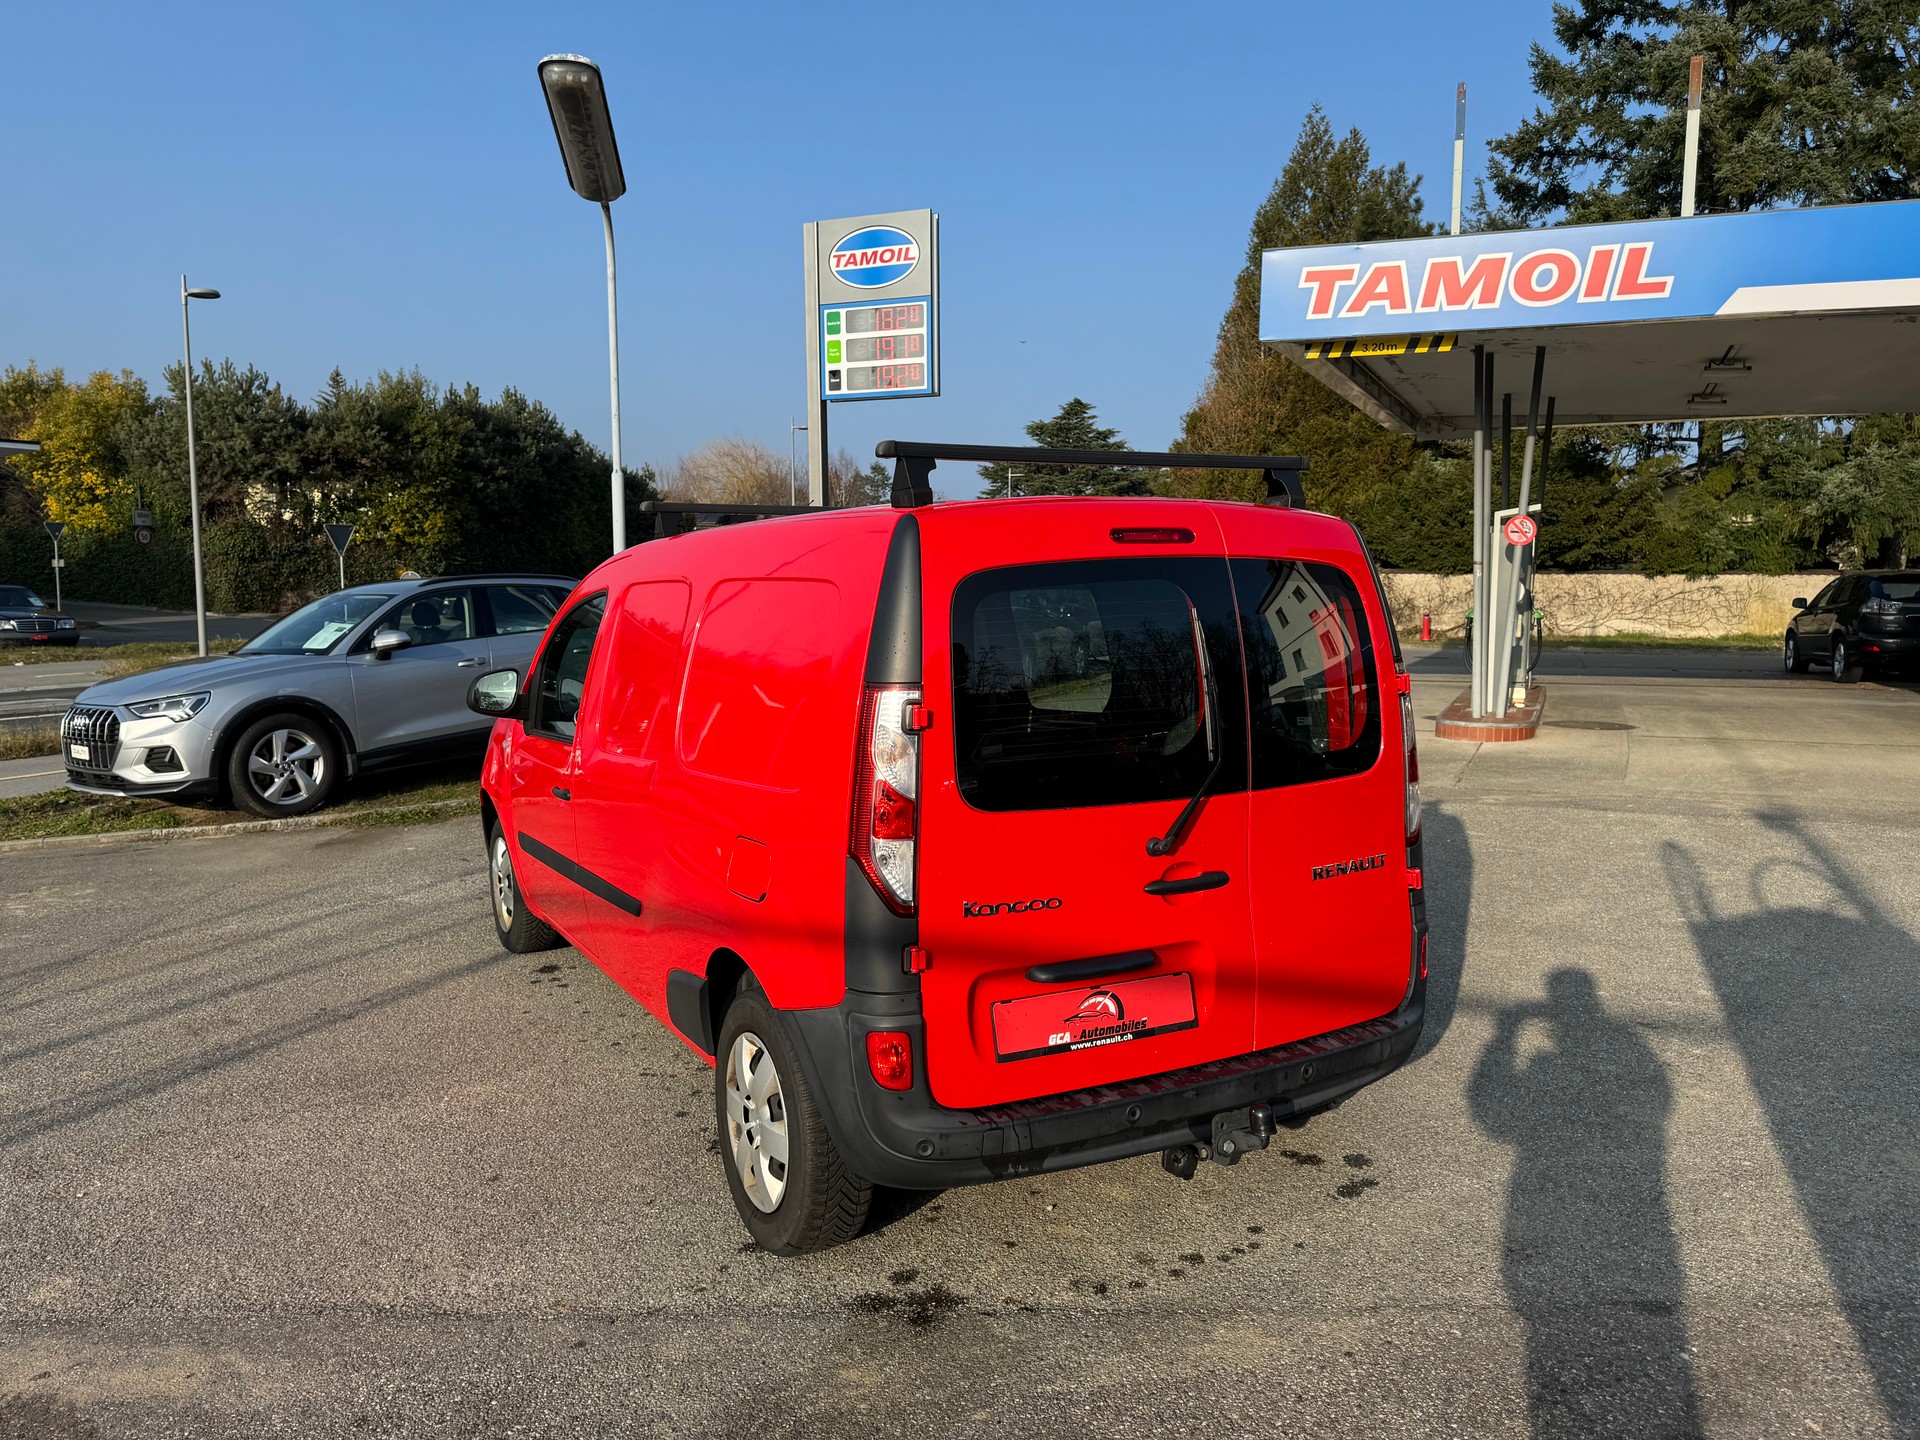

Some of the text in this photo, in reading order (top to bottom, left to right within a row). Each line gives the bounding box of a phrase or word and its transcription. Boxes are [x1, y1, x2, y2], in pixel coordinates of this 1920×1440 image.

[832, 247, 916, 269] TAMOIL
[1299, 241, 1674, 319] TAMOIL
[1361, 342, 1385, 353] 3.20
[141, 533, 148, 541] 50
[1311, 853, 1387, 881] RENAULT
[1048, 1019, 1148, 1046] GCA Automobiles
[1070, 1033, 1133, 1051] www.renault.ch
